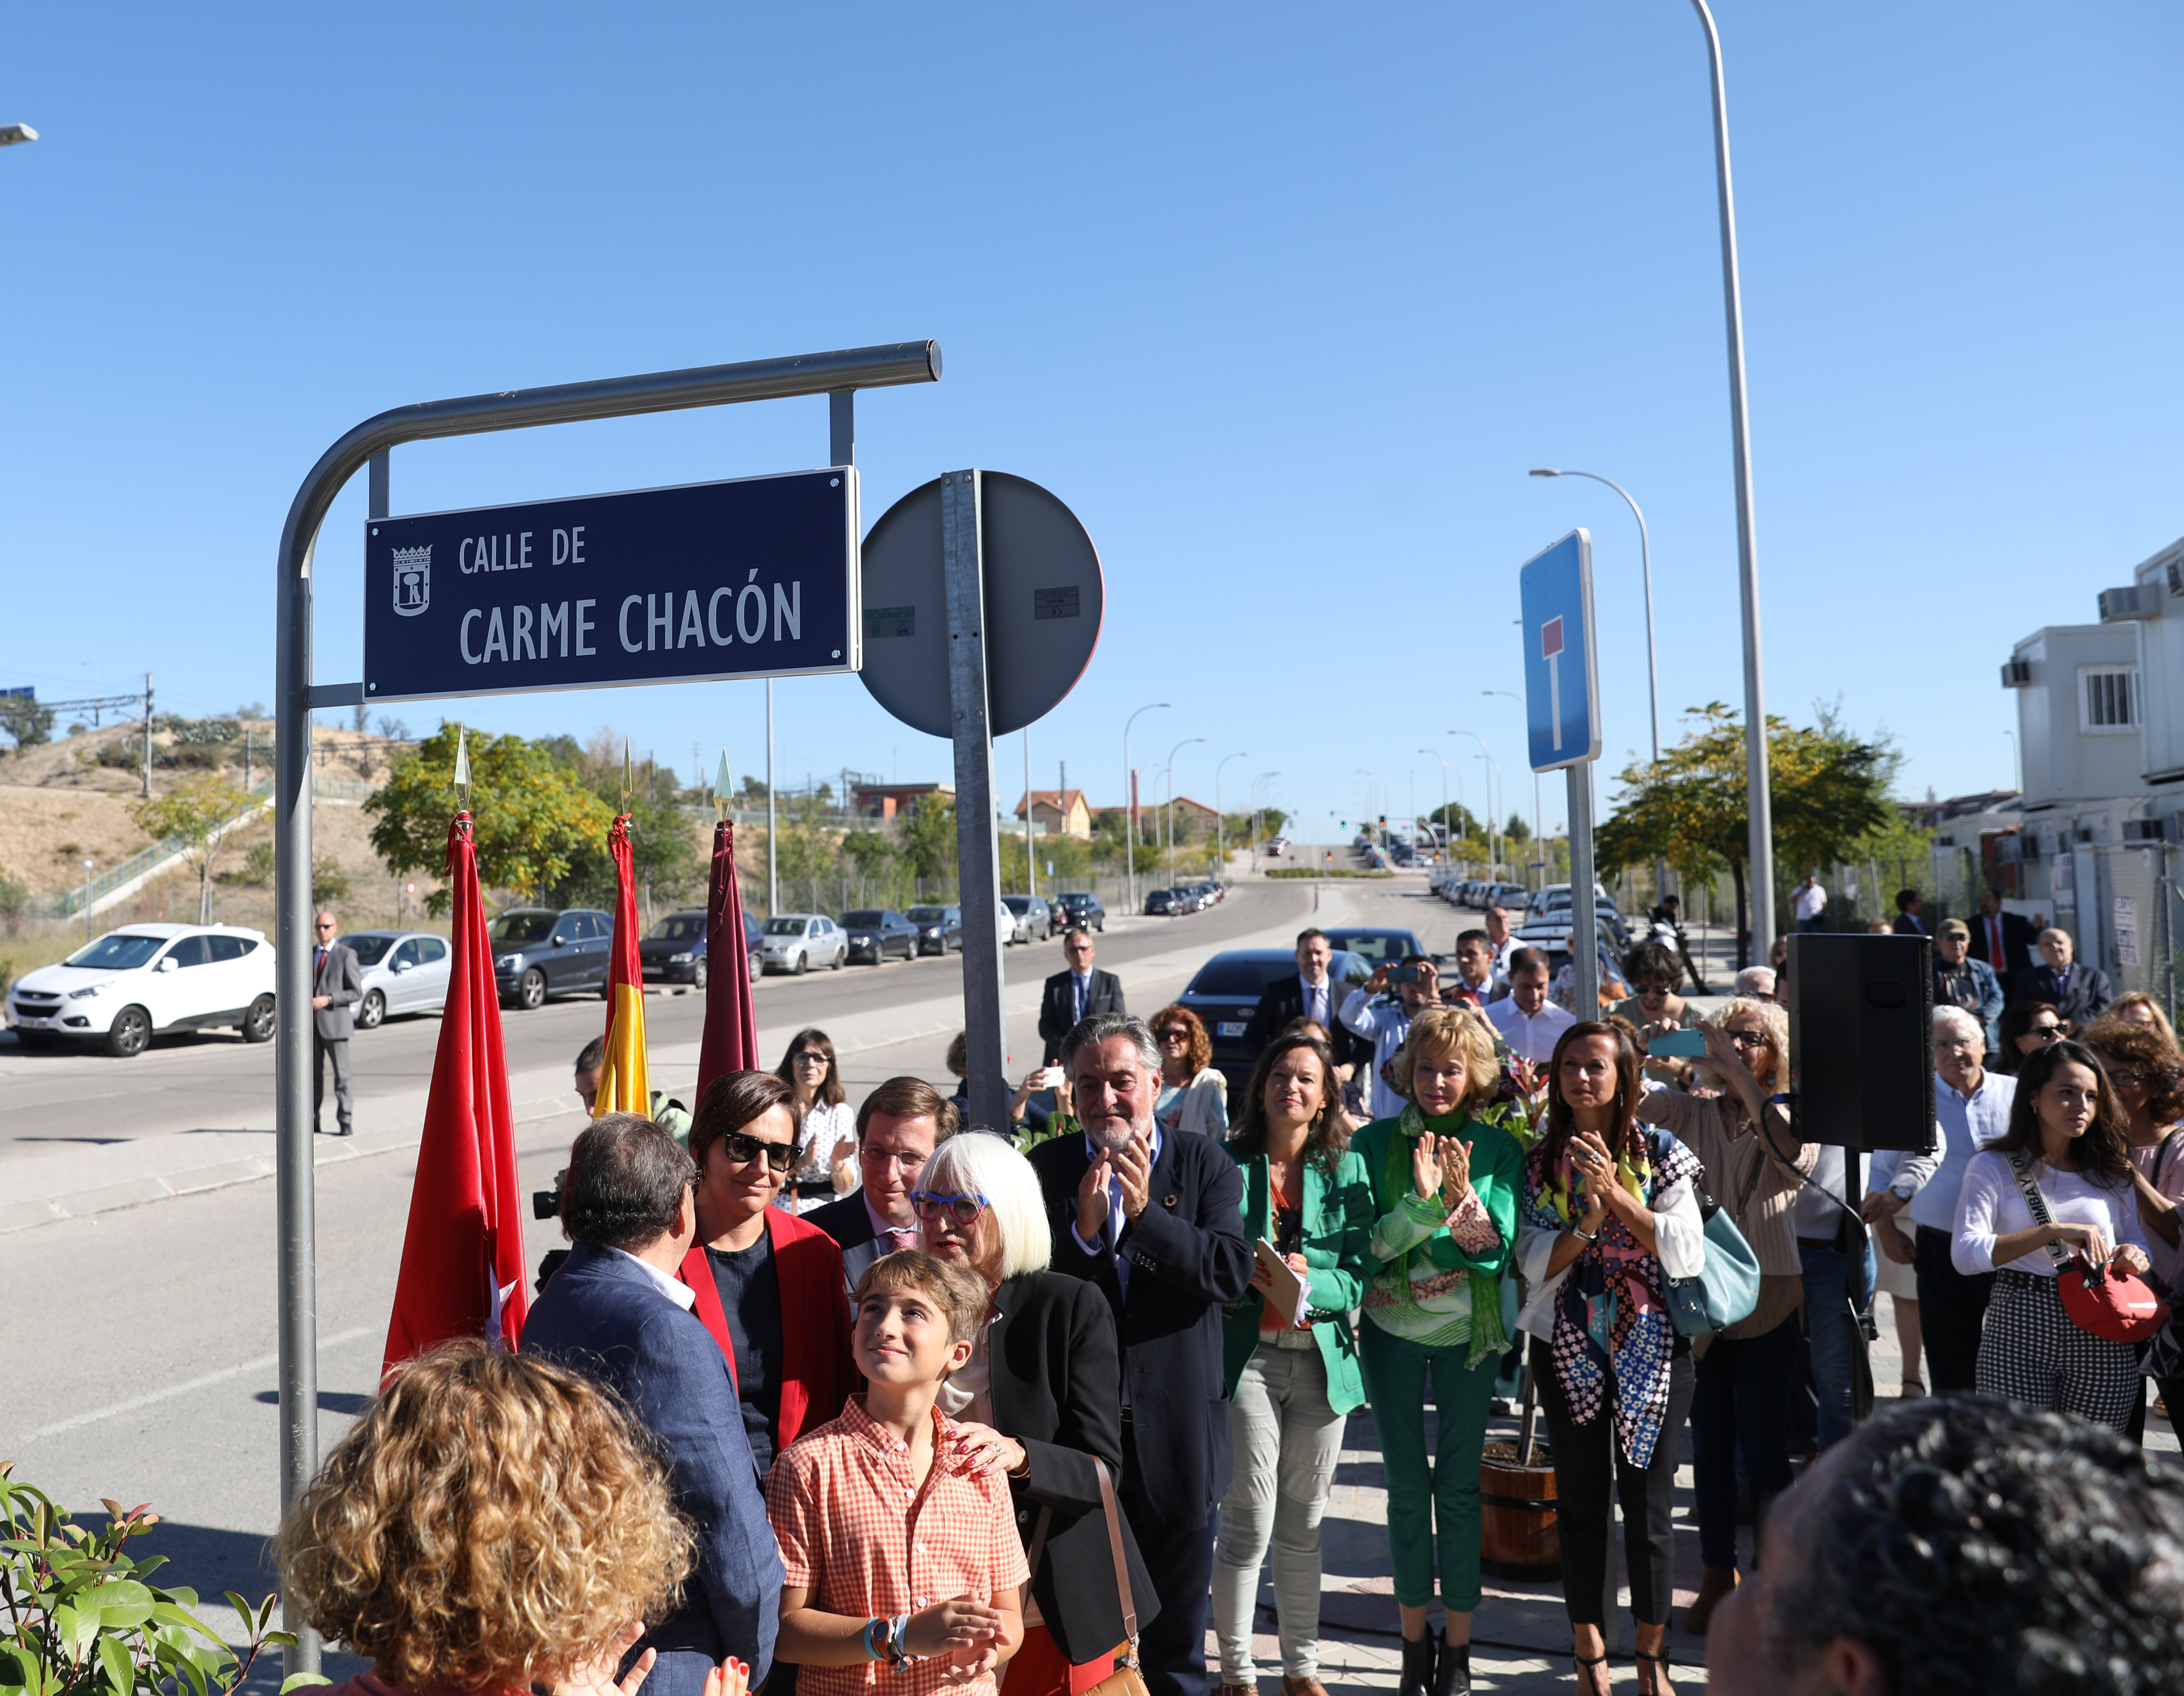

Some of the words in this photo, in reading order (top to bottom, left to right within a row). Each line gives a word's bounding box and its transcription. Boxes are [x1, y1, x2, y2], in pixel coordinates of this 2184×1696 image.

[459, 531, 533, 575] CALLE
[552, 526, 586, 566] DE
[460, 598, 596, 665] CARME
[618, 568, 801, 653] CHACÓN
[2019, 1178, 2032, 1187] Y
[2025, 1187, 2050, 1225] BIMBA
